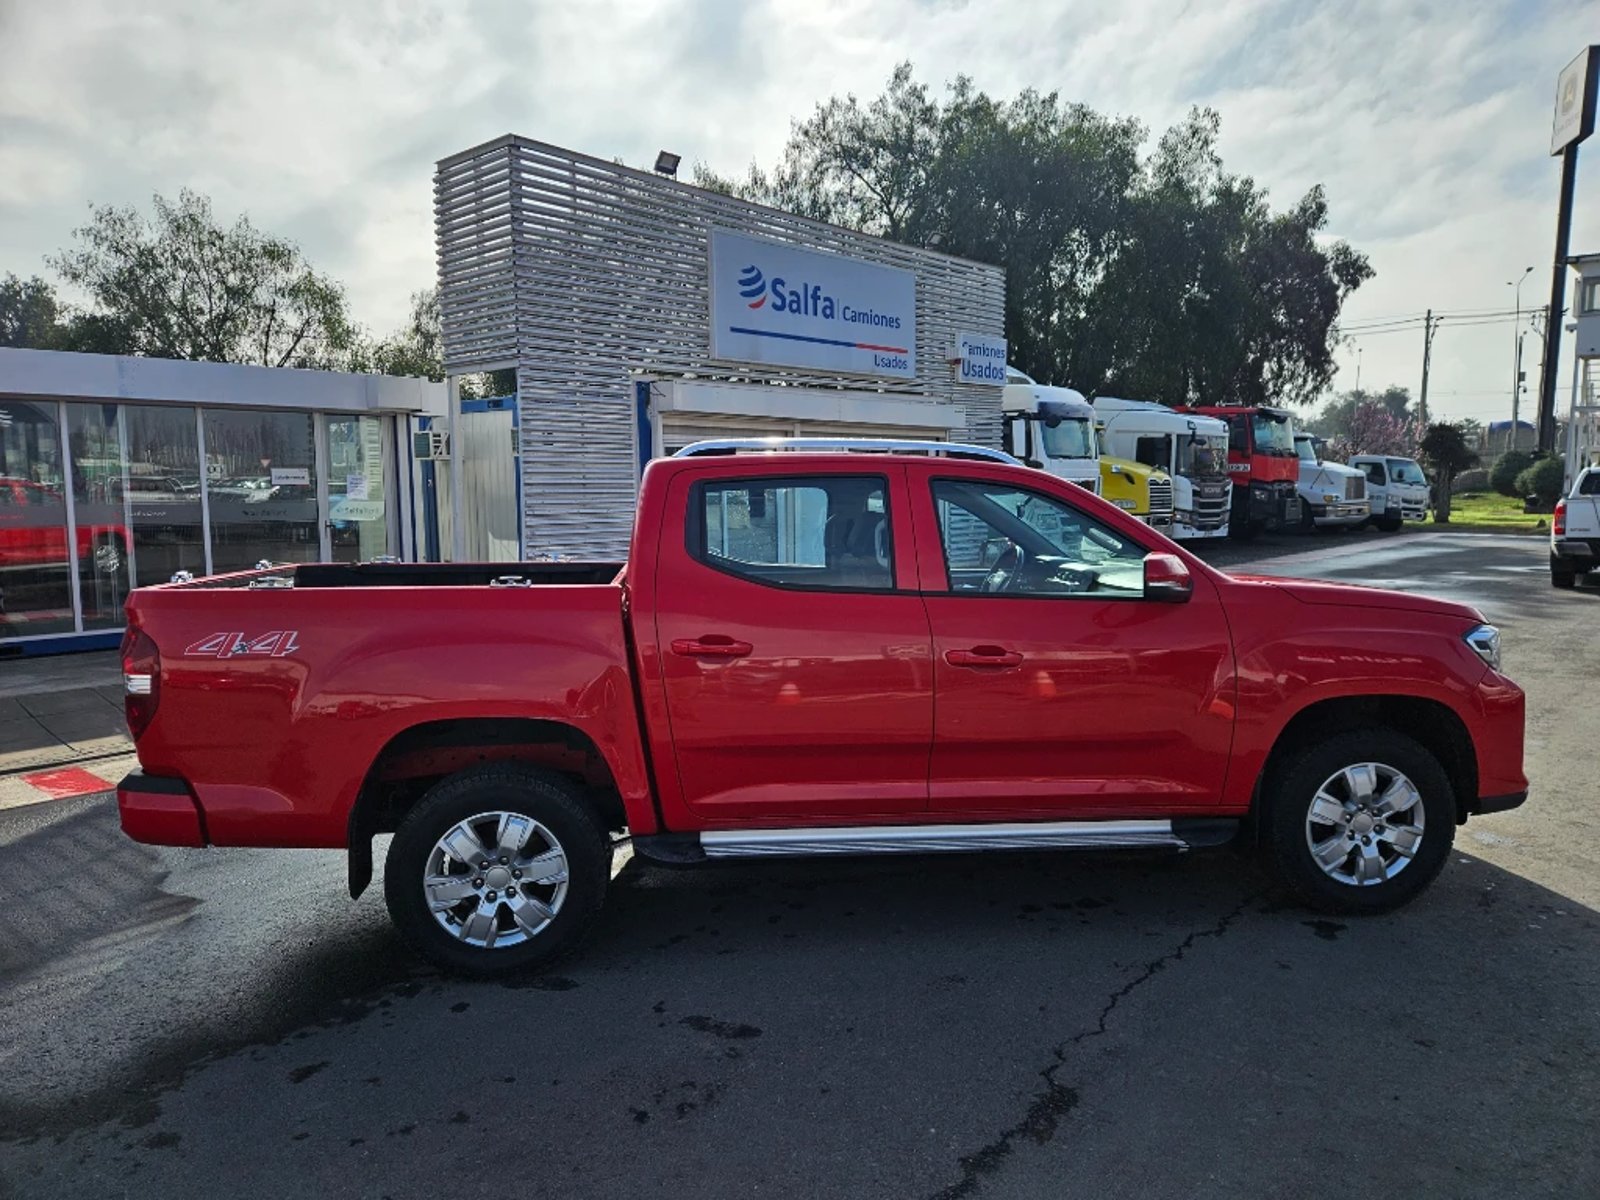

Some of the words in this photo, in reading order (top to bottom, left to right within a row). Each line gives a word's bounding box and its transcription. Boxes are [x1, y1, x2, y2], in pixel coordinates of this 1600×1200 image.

[771, 277, 835, 320] Salfa
[842, 305, 901, 329] Camiones
[874, 353, 909, 370] Usados
[962, 358, 1004, 381] Usados
